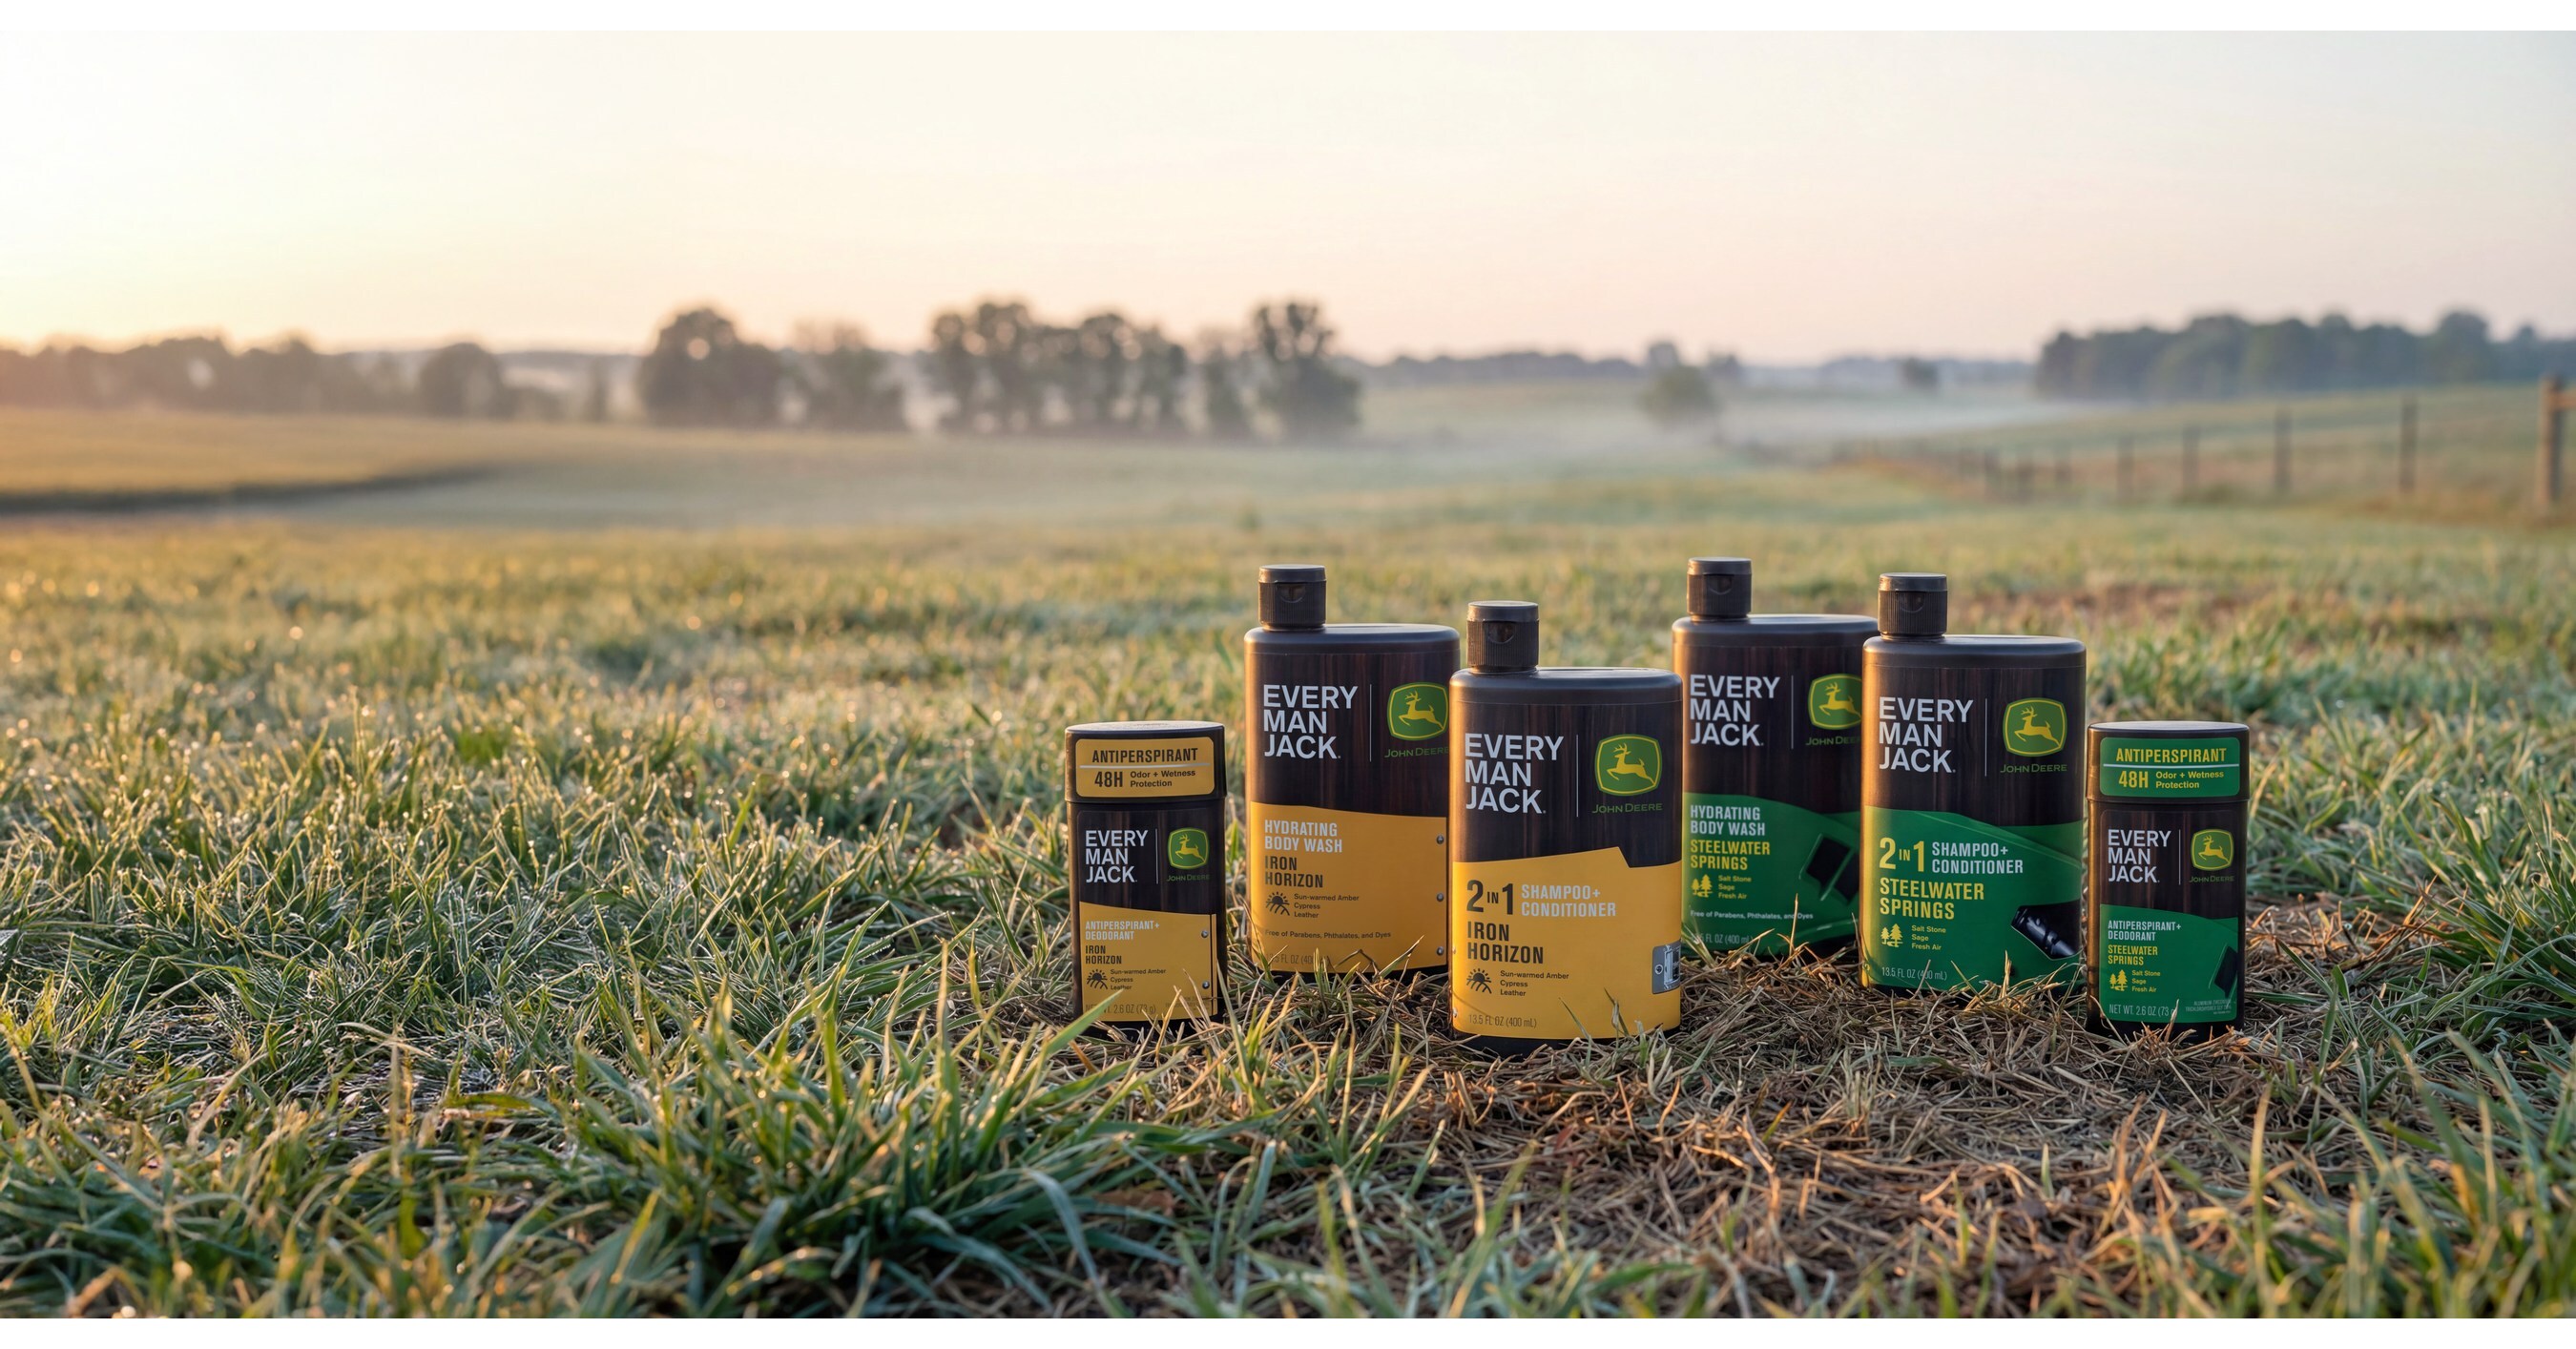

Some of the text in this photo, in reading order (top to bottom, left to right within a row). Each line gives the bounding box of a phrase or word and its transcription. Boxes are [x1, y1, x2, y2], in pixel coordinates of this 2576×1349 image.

[1690, 674, 1780, 698] EVERY
[1263, 685, 1358, 709] EVERY
[1691, 698, 1751, 722] MAN
[1880, 696, 1973, 723] EVERY
[1264, 710, 1327, 735] MAN
[1880, 721, 1942, 747] MAN
[1384, 749, 1414, 758] JOHN
[1465, 733, 1564, 760] EVERY
[1092, 748, 1198, 763] ANTIPERSPIRANT
[2116, 748, 2227, 763] ANTIPERSPIRANT
[1465, 759, 1531, 786] MAN
[2000, 765, 2030, 774] JOHN
[1094, 771, 1123, 787] 48H
[2119, 771, 2149, 788] 48H
[1592, 803, 1662, 814] JOHN DEERE
[1691, 805, 1760, 820] HYDRATING
[1265, 820, 1338, 837] HYDRATING
[1691, 820, 1765, 836] BODY WASH
[1086, 830, 1148, 847] EVERY
[1265, 836, 1342, 853] BODY WASH
[2109, 829, 2171, 847] EVERY
[1691, 840, 1770, 855] STEELWATER
[1880, 838, 1924, 872] 2 IN 1
[1932, 841, 2008, 857] SHAMPOO+
[1086, 848, 1128, 864] MAN
[1691, 855, 1747, 870] SPRINGS
[2109, 847, 2150, 864] MAN
[1265, 856, 1298, 871] IRON
[1932, 859, 2024, 874] CONDITIONER
[1265, 872, 1323, 888] HORIZON
[1522, 884, 1601, 900] SHAMPOO+
[1880, 878, 1984, 900] STEELWATER
[1466, 880, 1514, 915] 2 IN 1
[1522, 902, 1616, 917] CONDITIONER
[1880, 898, 1954, 920] SPRINGS
[1086, 921, 1159, 930] ANTIPERSPIRANT+
[1468, 921, 1509, 941] IRON
[2109, 920, 2181, 930] ANTIPERSPIRANT+
[1086, 931, 1134, 941] DEODORANT
[1705, 933, 1714, 944] FL
[1714, 933, 1724, 944] OZ
[1725, 934, 1740, 945] (400
[2109, 931, 2156, 941] DEODORANT
[1086, 945, 1106, 954] IRON
[1468, 943, 1544, 965] HORIZON
[2109, 944, 2158, 955] STEELWATER
[1086, 956, 1122, 965] HORIZON
[2109, 955, 2144, 965] SPRINGS
[1500, 970, 1544, 979] Sun-warmed
[1881, 966, 1947, 981] 13.5 FL OZ (40 mL)
[1500, 980, 1528, 988] Cypress
[1113, 1004, 1125, 1014] 2.6
[1126, 1004, 1135, 1014] OZ
[2109, 1005, 2122, 1014] NET
[2136, 1007, 2147, 1015] 2.6
[2148, 1007, 2156, 1016] OZ
[2158, 1007, 2170, 1017] (73
[1469, 1014, 1537, 1028] 13.5 FL OZ (400 mL)
